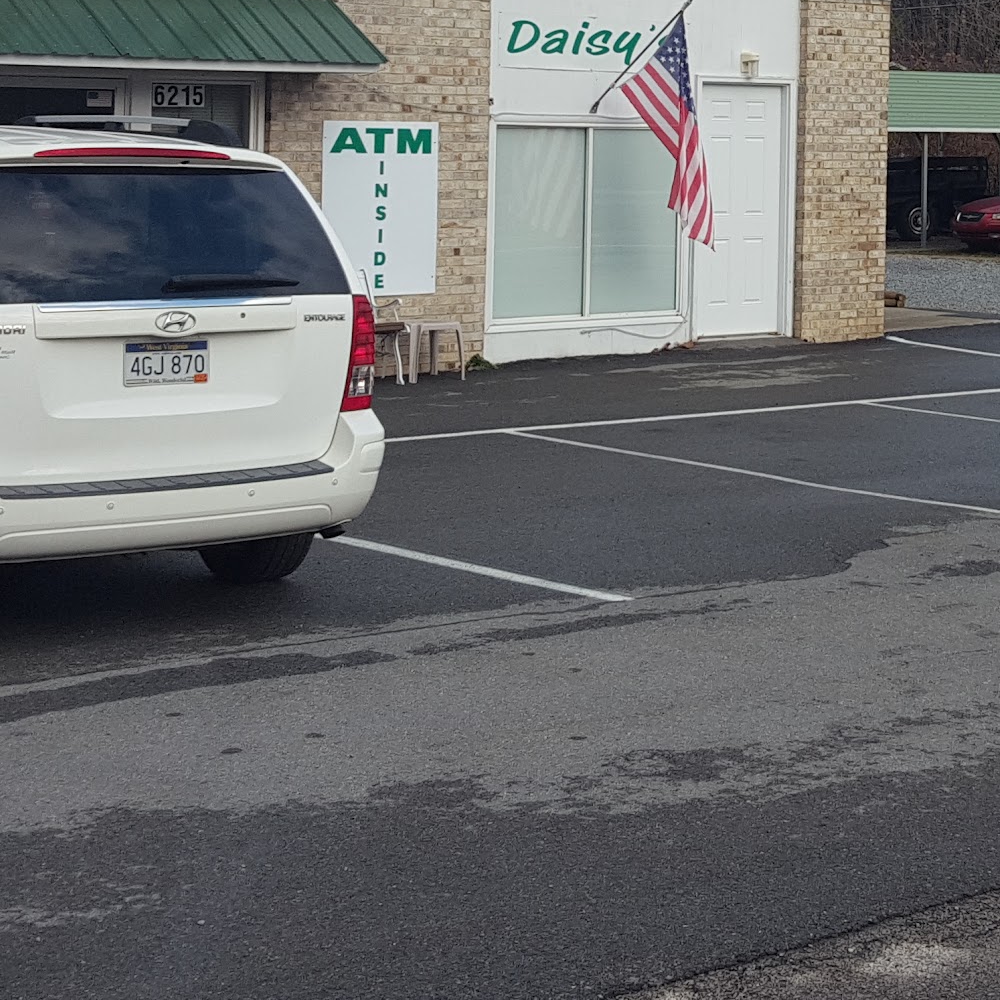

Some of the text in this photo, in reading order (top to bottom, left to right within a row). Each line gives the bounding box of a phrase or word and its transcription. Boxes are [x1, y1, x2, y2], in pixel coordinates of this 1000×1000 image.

[507, 19, 669, 65] Daisy'
[154, 85, 203, 106] 6215
[330, 127, 433, 154] ATM
[374, 160, 388, 289] INSIDE
[303, 313, 346, 322] ENTOURAGE
[130, 354, 205, 376] 4GJ 870
